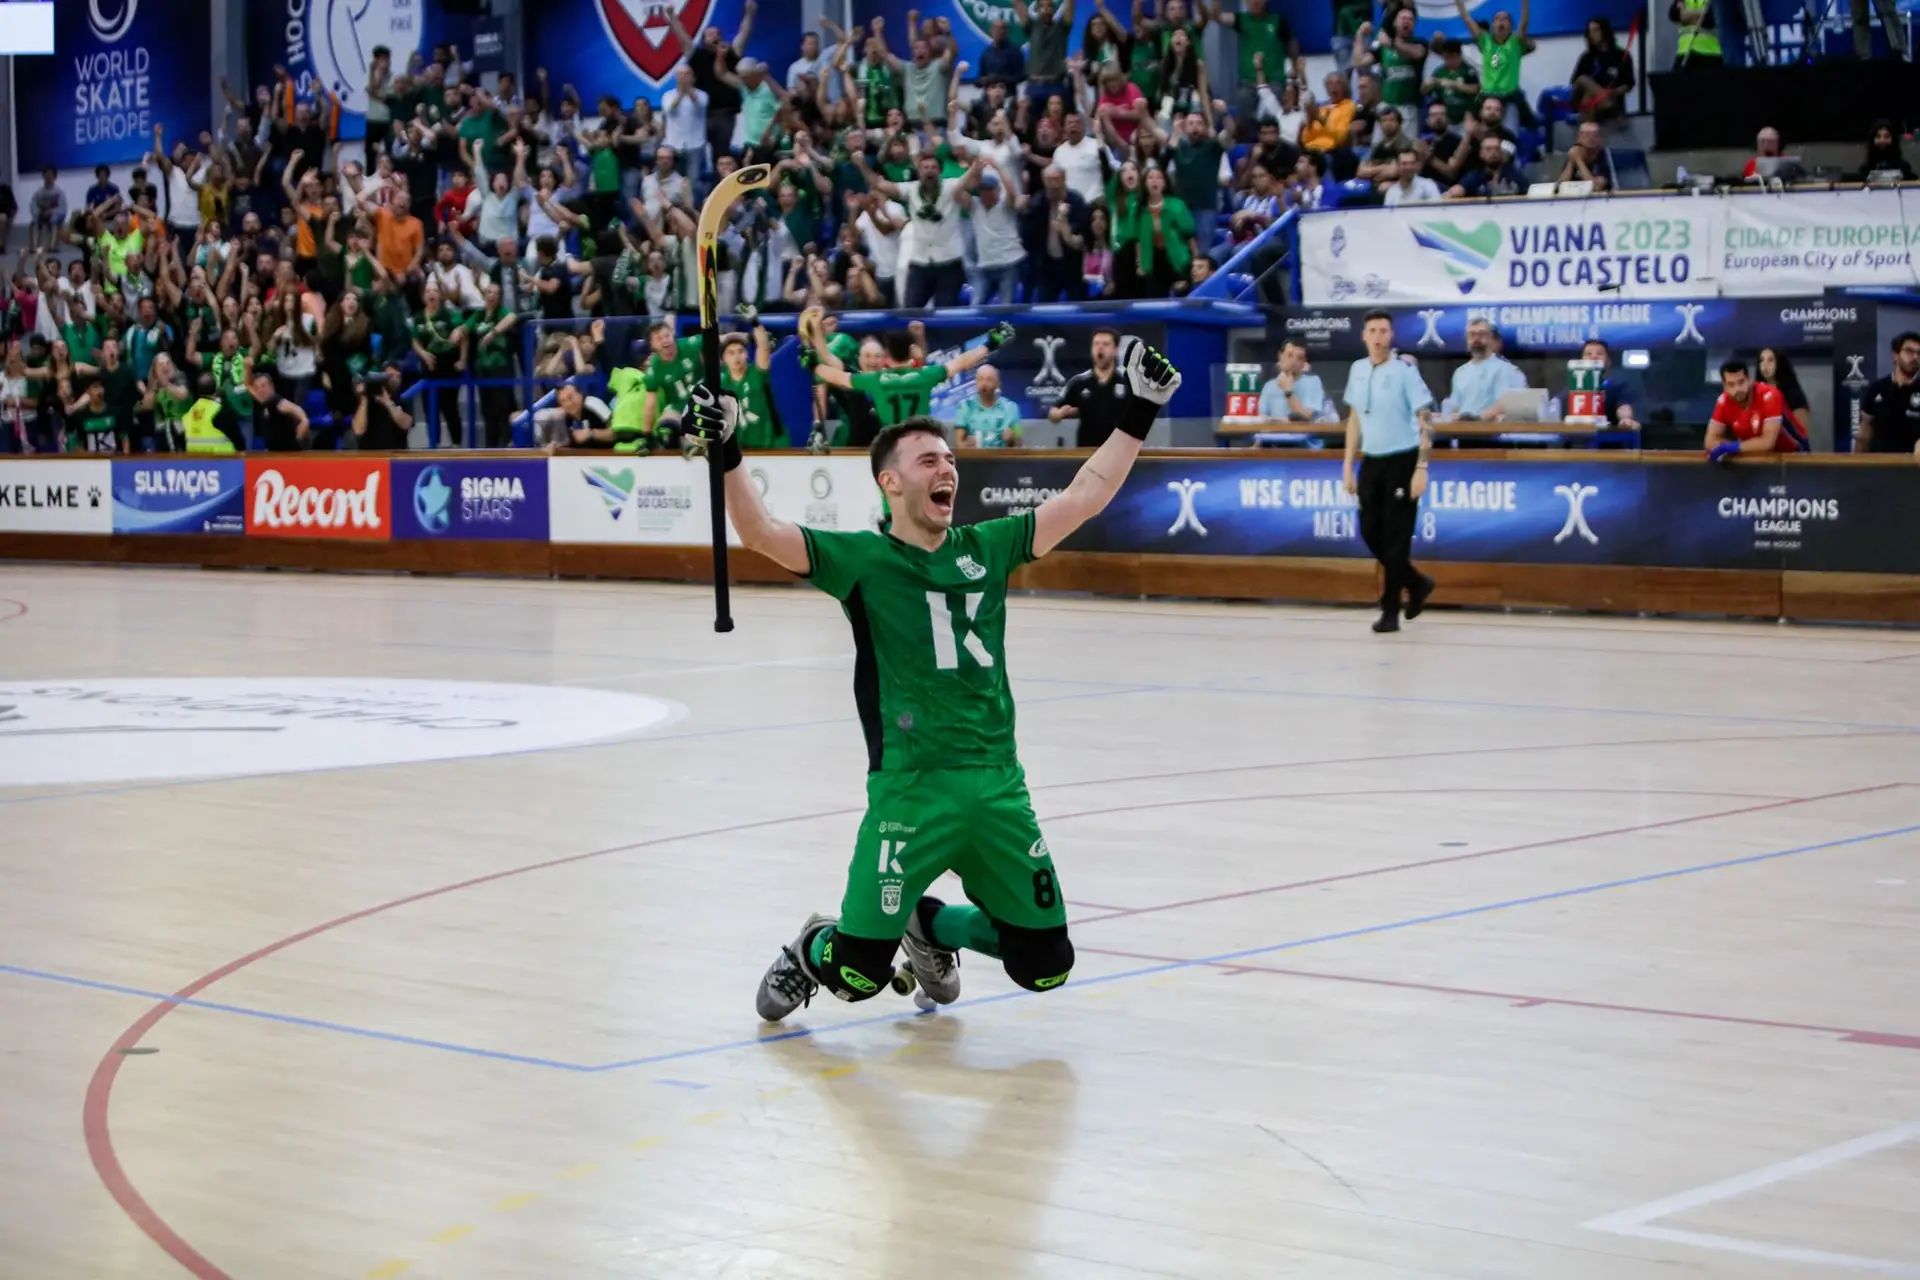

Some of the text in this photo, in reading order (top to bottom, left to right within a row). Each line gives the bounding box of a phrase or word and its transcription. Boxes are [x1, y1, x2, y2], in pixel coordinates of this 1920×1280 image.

[75, 47, 149, 81] WORLD
[75, 76, 149, 114] SKATE
[75, 111, 149, 144] EUROPE
[1510, 219, 1691, 254] VIANA 2023
[1725, 226, 1806, 249] CIDADE
[1509, 254, 1690, 288] DO CASTELO
[1724, 250, 1911, 271] European City of Sport
[1286, 317, 1351, 332] CHAMPIONS
[1501, 305, 1590, 324] CHAMPIONS
[1594, 303, 1651, 323] LEAGUE
[1780, 307, 1857, 322] CHAMPIONS
[1516, 324, 1545, 344] MEN
[1548, 323, 1584, 342] FINAL
[888, 393, 921, 424] 17
[0, 485, 79, 508] KELME
[253, 469, 382, 528] Record
[460, 477, 525, 499] SIGMA
[1240, 479, 1282, 508] WSE
[1430, 480, 1517, 509] LEAGUE
[461, 499, 513, 521] STARS
[1718, 497, 1839, 519] CHAMPIONS
[1313, 510, 1436, 542] MEN 8
[1754, 520, 1801, 533] LEAGUE
[925, 590, 994, 669] K
[878, 839, 907, 874] K
